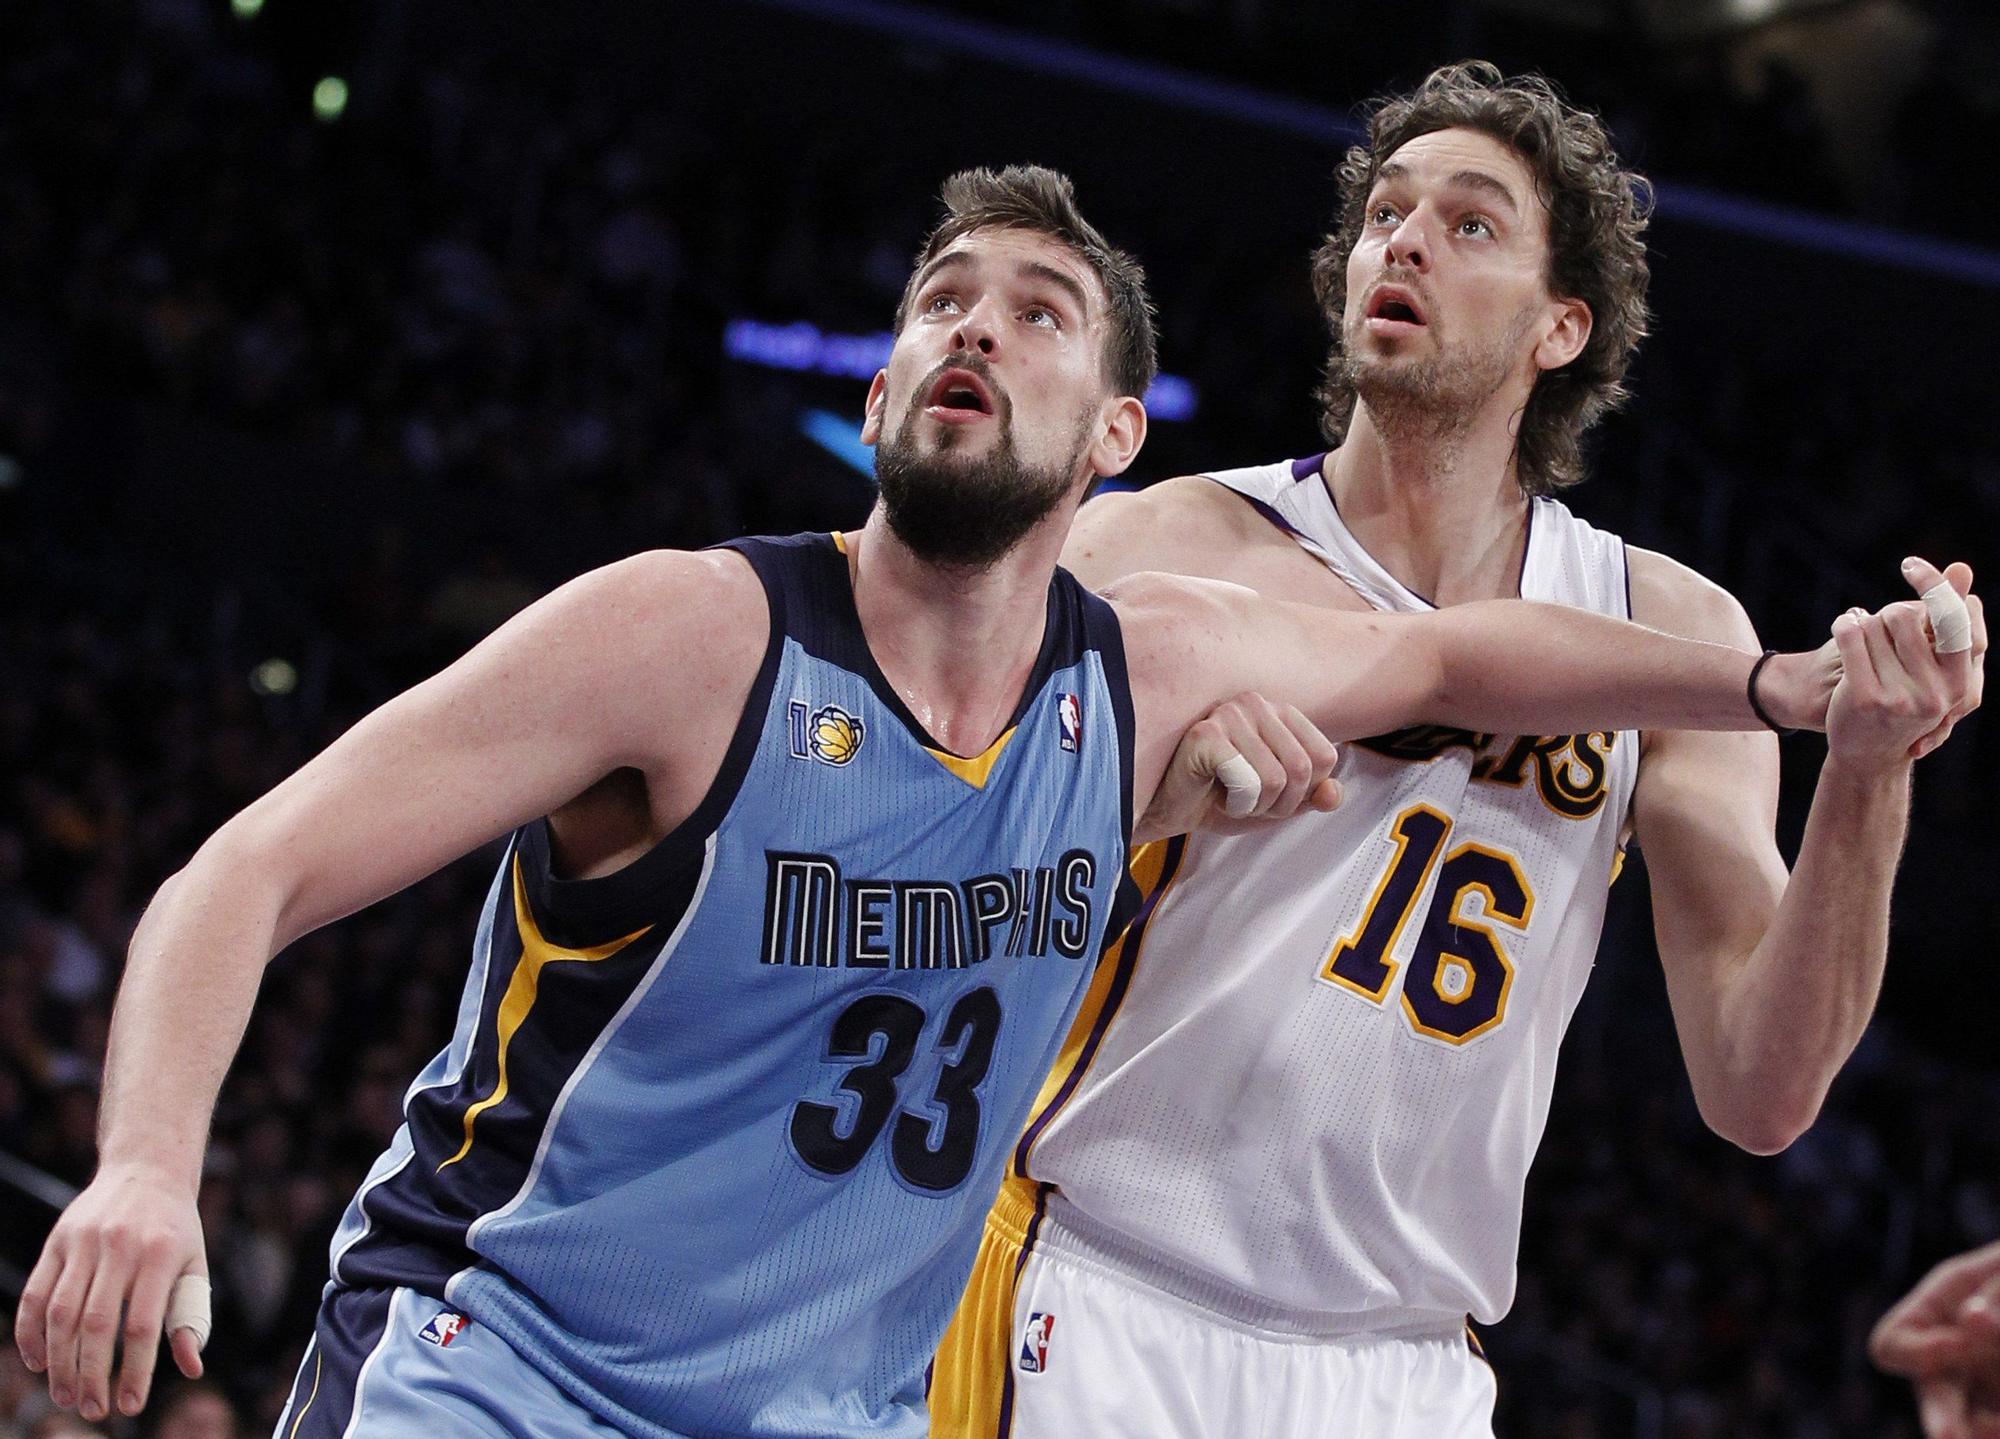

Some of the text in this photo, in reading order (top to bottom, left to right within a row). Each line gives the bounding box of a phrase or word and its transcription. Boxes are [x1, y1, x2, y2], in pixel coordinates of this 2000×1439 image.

[760, 848, 1097, 970] MEMPHIS
[1316, 800, 1536, 1047] 16
[788, 986, 1001, 1195] 33
